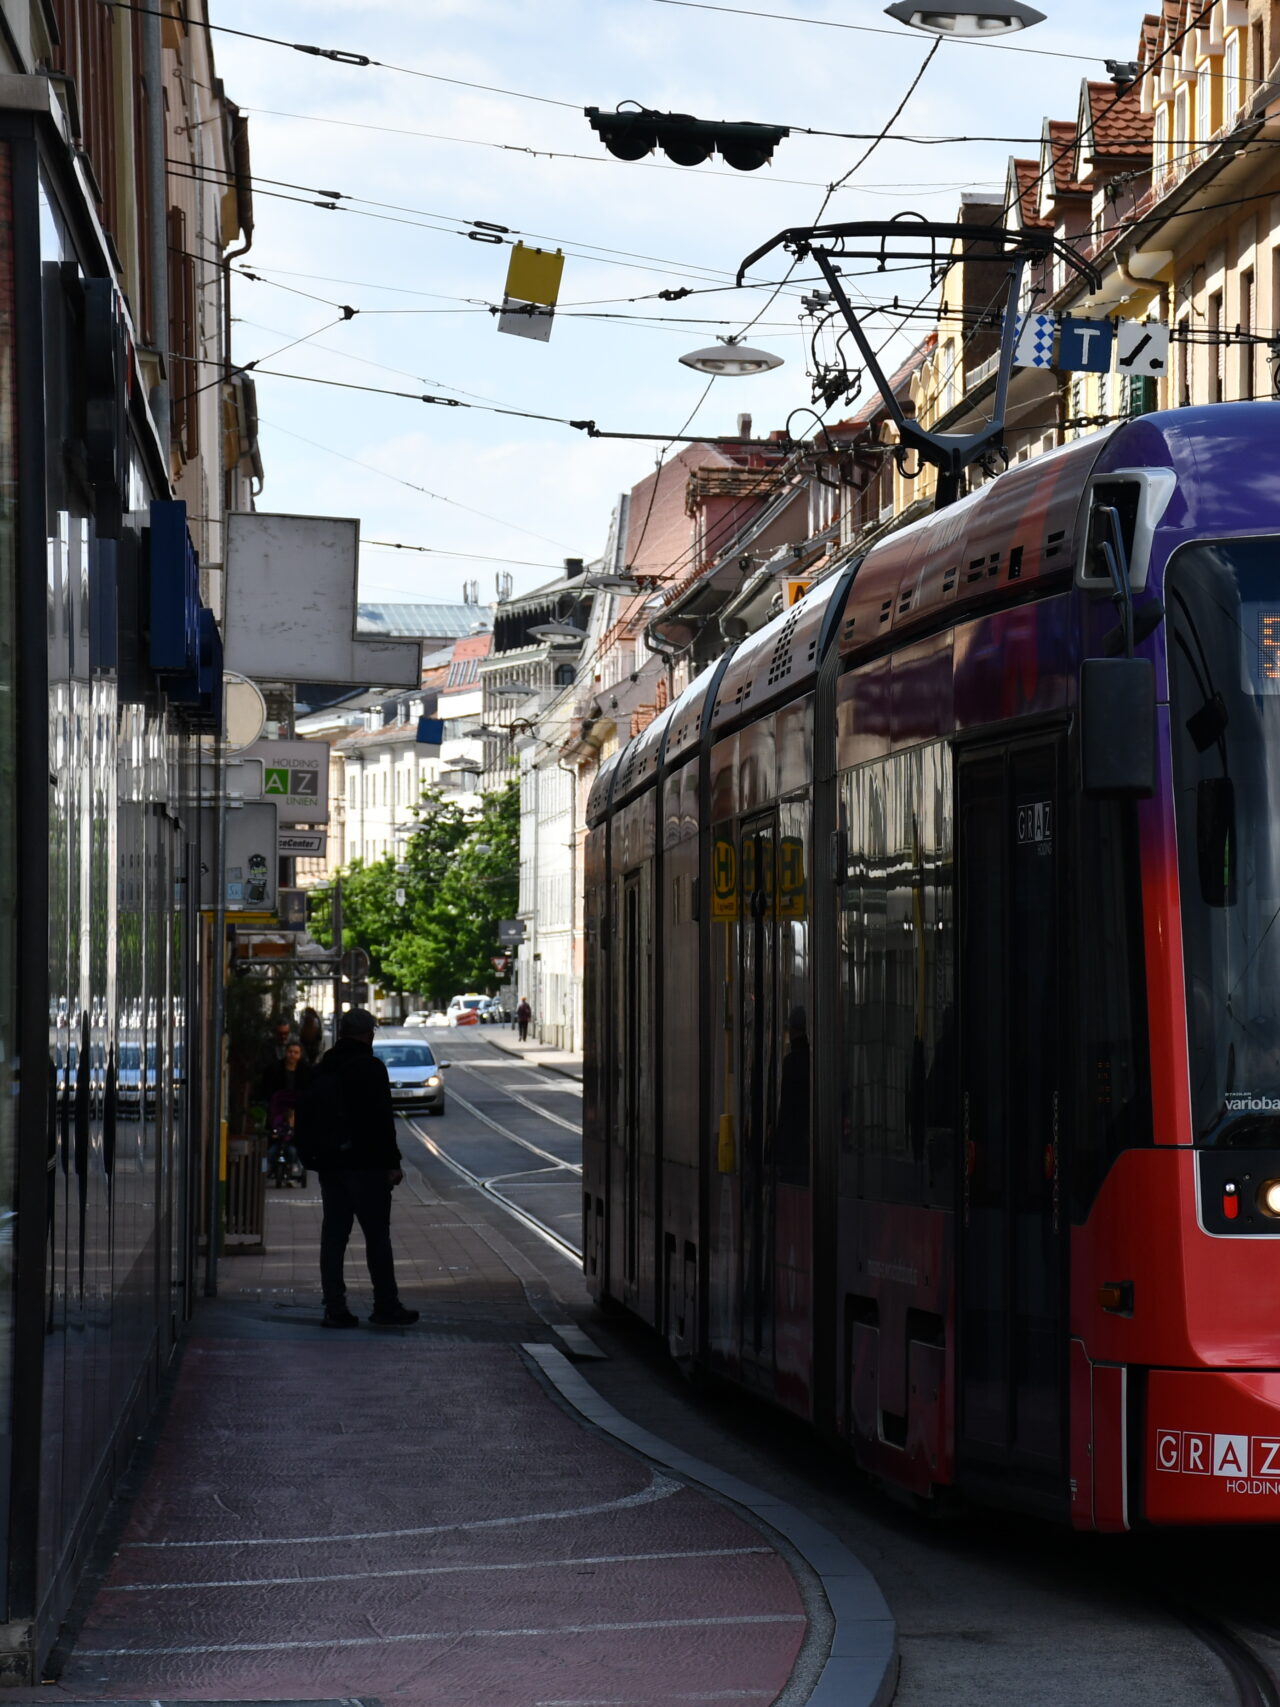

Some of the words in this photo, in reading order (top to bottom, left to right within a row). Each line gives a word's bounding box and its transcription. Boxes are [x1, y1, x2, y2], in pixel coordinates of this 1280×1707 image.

[1073, 328, 1101, 365] T
[272, 758, 320, 769] HOLDING
[285, 797, 318, 807] LINIEN
[279, 838, 315, 848] ceCenter
